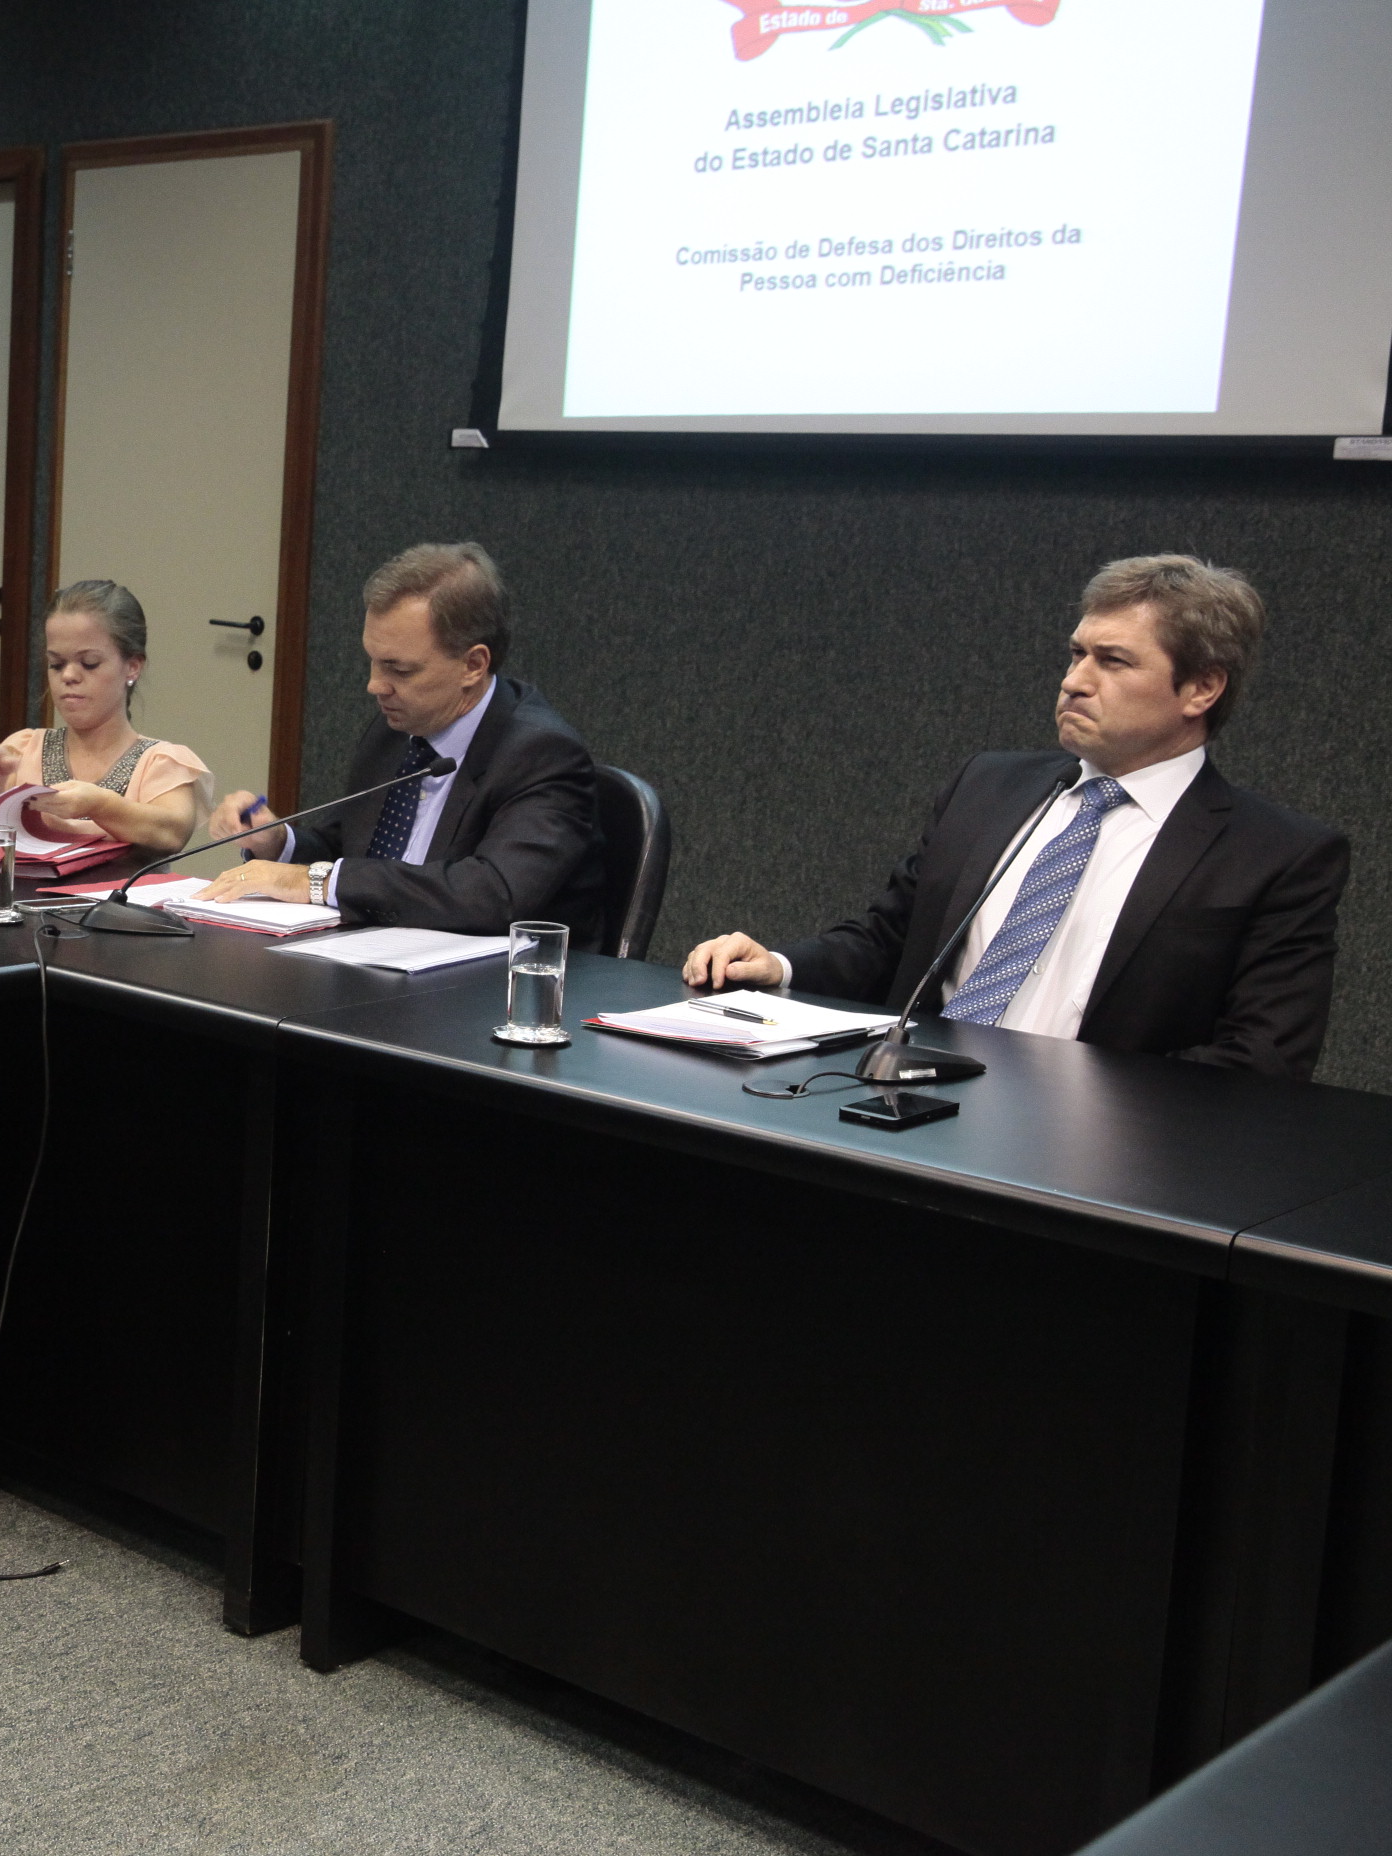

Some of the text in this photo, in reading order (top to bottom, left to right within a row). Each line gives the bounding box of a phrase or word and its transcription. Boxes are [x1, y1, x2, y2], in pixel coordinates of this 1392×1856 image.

[759, 10, 848, 33] Estado de
[724, 83, 1018, 132] Assembleia Legislativa
[694, 123, 1056, 173] do Estado de Santa Catarina
[675, 223, 1082, 266] Comissão de Defesa dos Direitos da
[739, 259, 1007, 292] Pessoa com Deficiência
